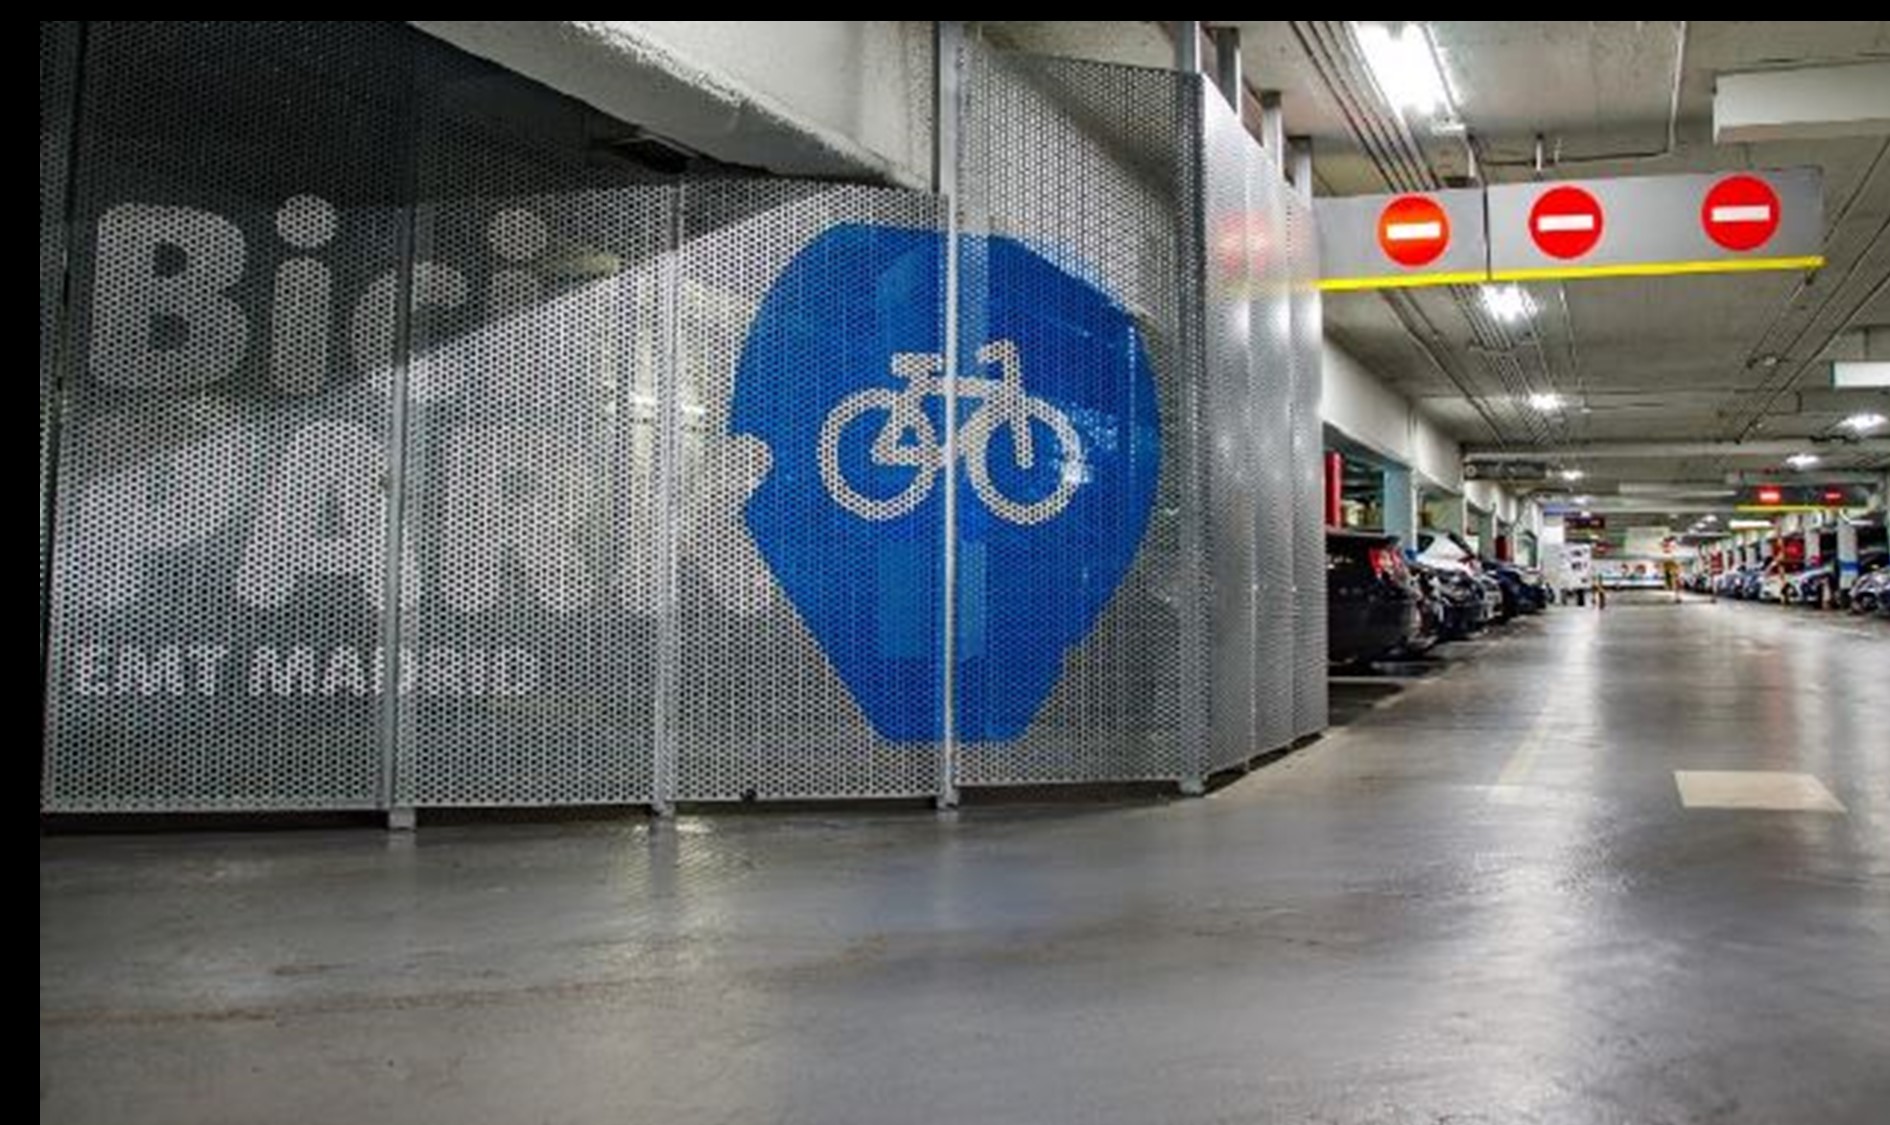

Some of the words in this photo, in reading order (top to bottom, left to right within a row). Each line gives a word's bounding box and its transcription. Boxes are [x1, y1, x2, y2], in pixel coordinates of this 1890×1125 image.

[66, 414, 774, 615] PARK
[72, 644, 228, 698] EMT
[247, 644, 541, 698] MADRID
